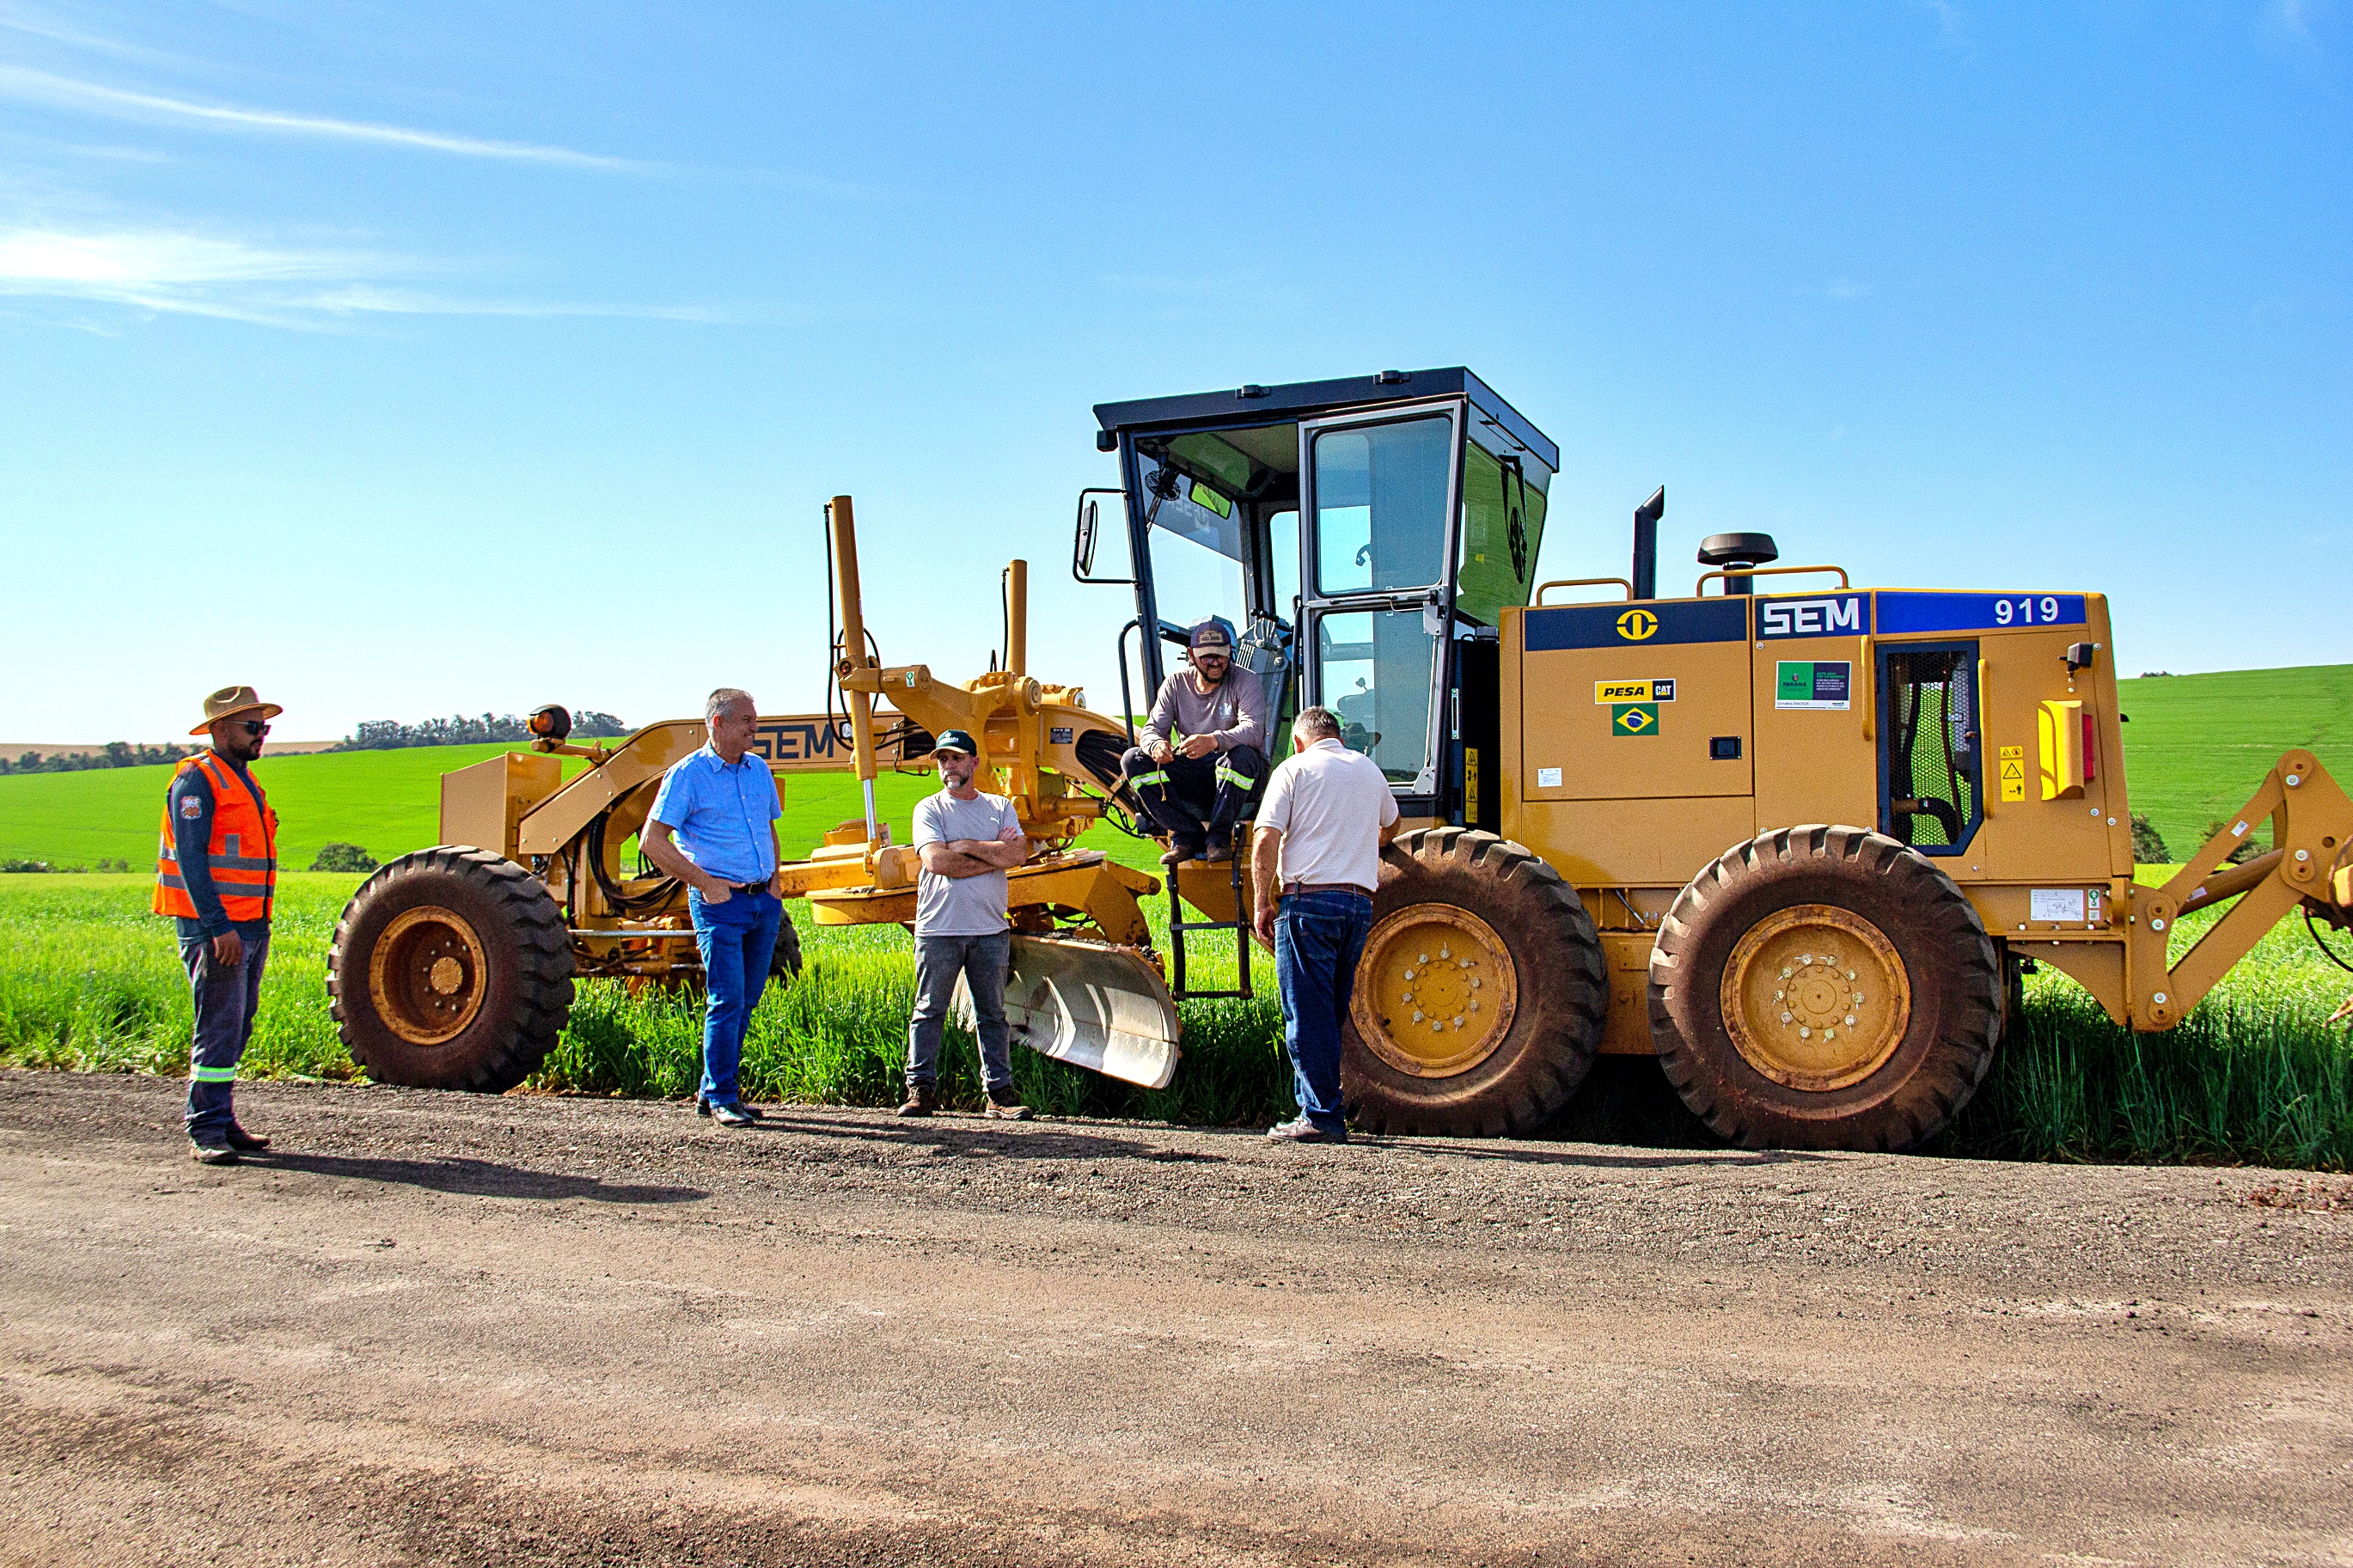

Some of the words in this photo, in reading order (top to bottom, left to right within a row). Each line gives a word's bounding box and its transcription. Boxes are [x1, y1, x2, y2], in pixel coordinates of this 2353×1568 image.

[1763, 598, 1860, 634] SEM
[1994, 596, 2059, 625] 919
[1604, 686, 1645, 697] PESA
[1655, 685, 1672, 696] CAT
[753, 723, 834, 760] SEM
